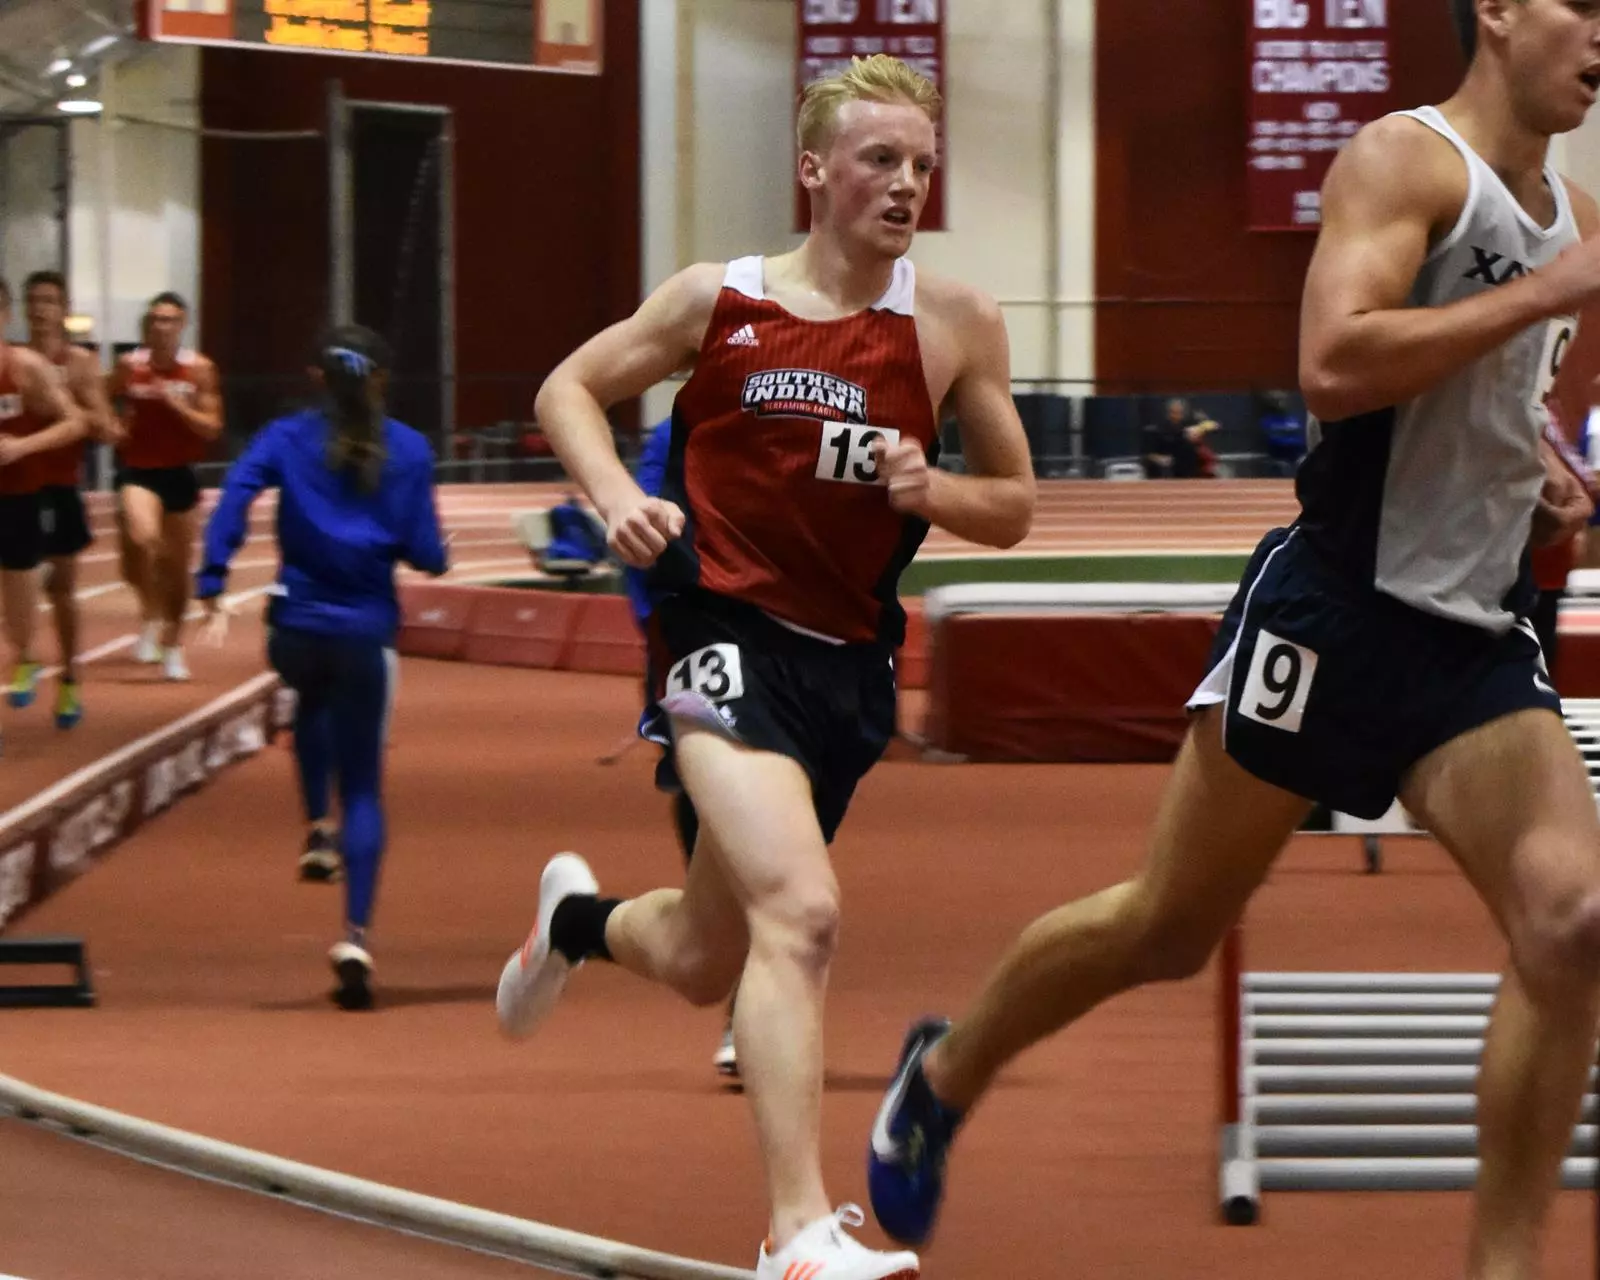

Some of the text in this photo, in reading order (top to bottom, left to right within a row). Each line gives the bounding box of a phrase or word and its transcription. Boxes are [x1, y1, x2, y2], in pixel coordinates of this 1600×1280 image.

[744, 383, 866, 421] INDIANA
[747, 371, 863, 403] SOUTHERN
[764, 401, 811, 413] SCREAMING
[830, 427, 887, 482] 13
[673, 649, 731, 697] 13
[1255, 643, 1302, 720] 9
